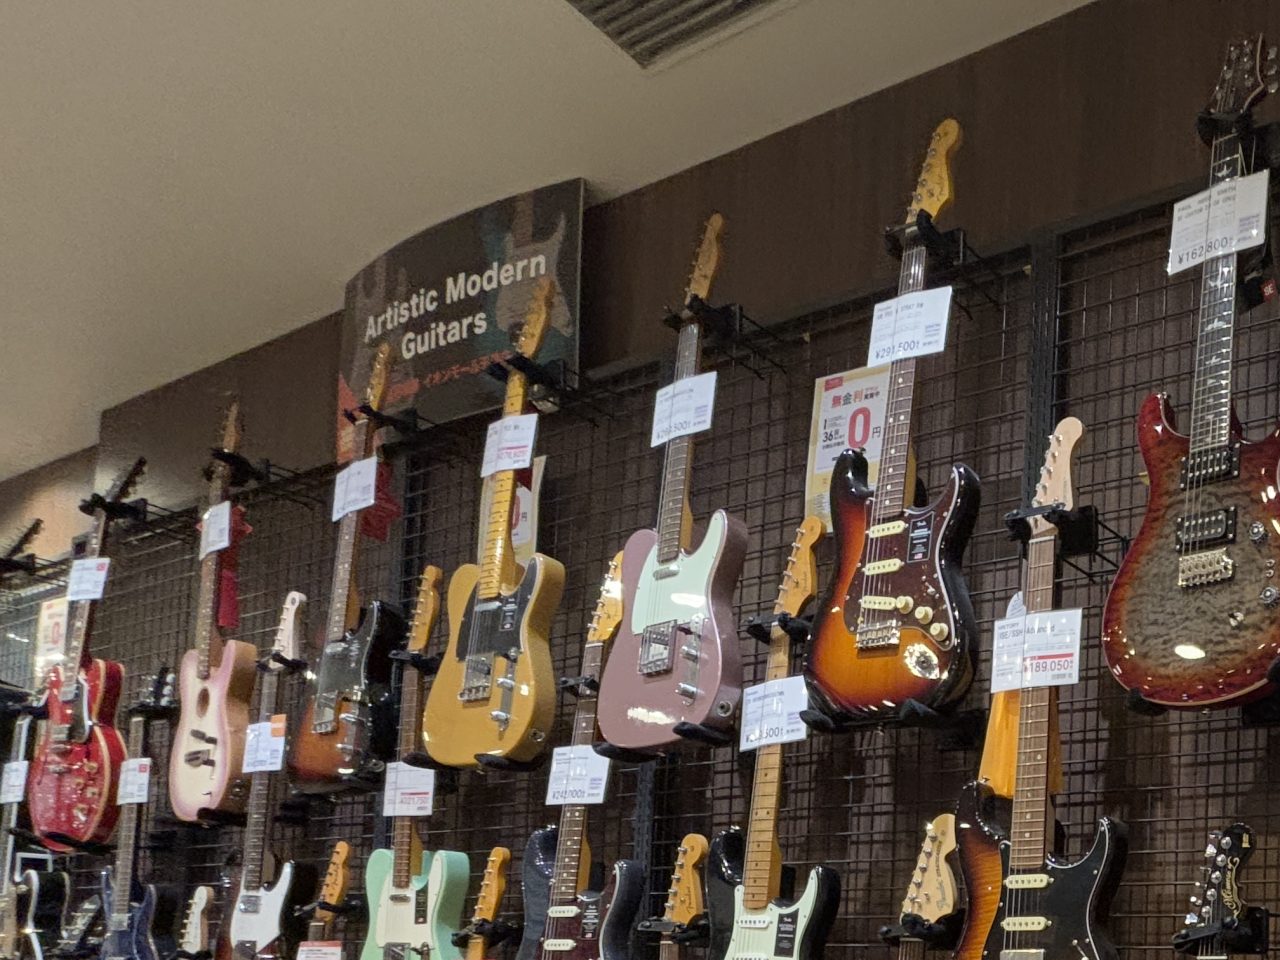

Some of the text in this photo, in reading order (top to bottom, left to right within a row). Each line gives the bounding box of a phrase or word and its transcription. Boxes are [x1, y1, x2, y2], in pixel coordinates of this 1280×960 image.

[363, 253, 547, 344] Artistic Modern
[400, 311, 488, 360] Guitars
